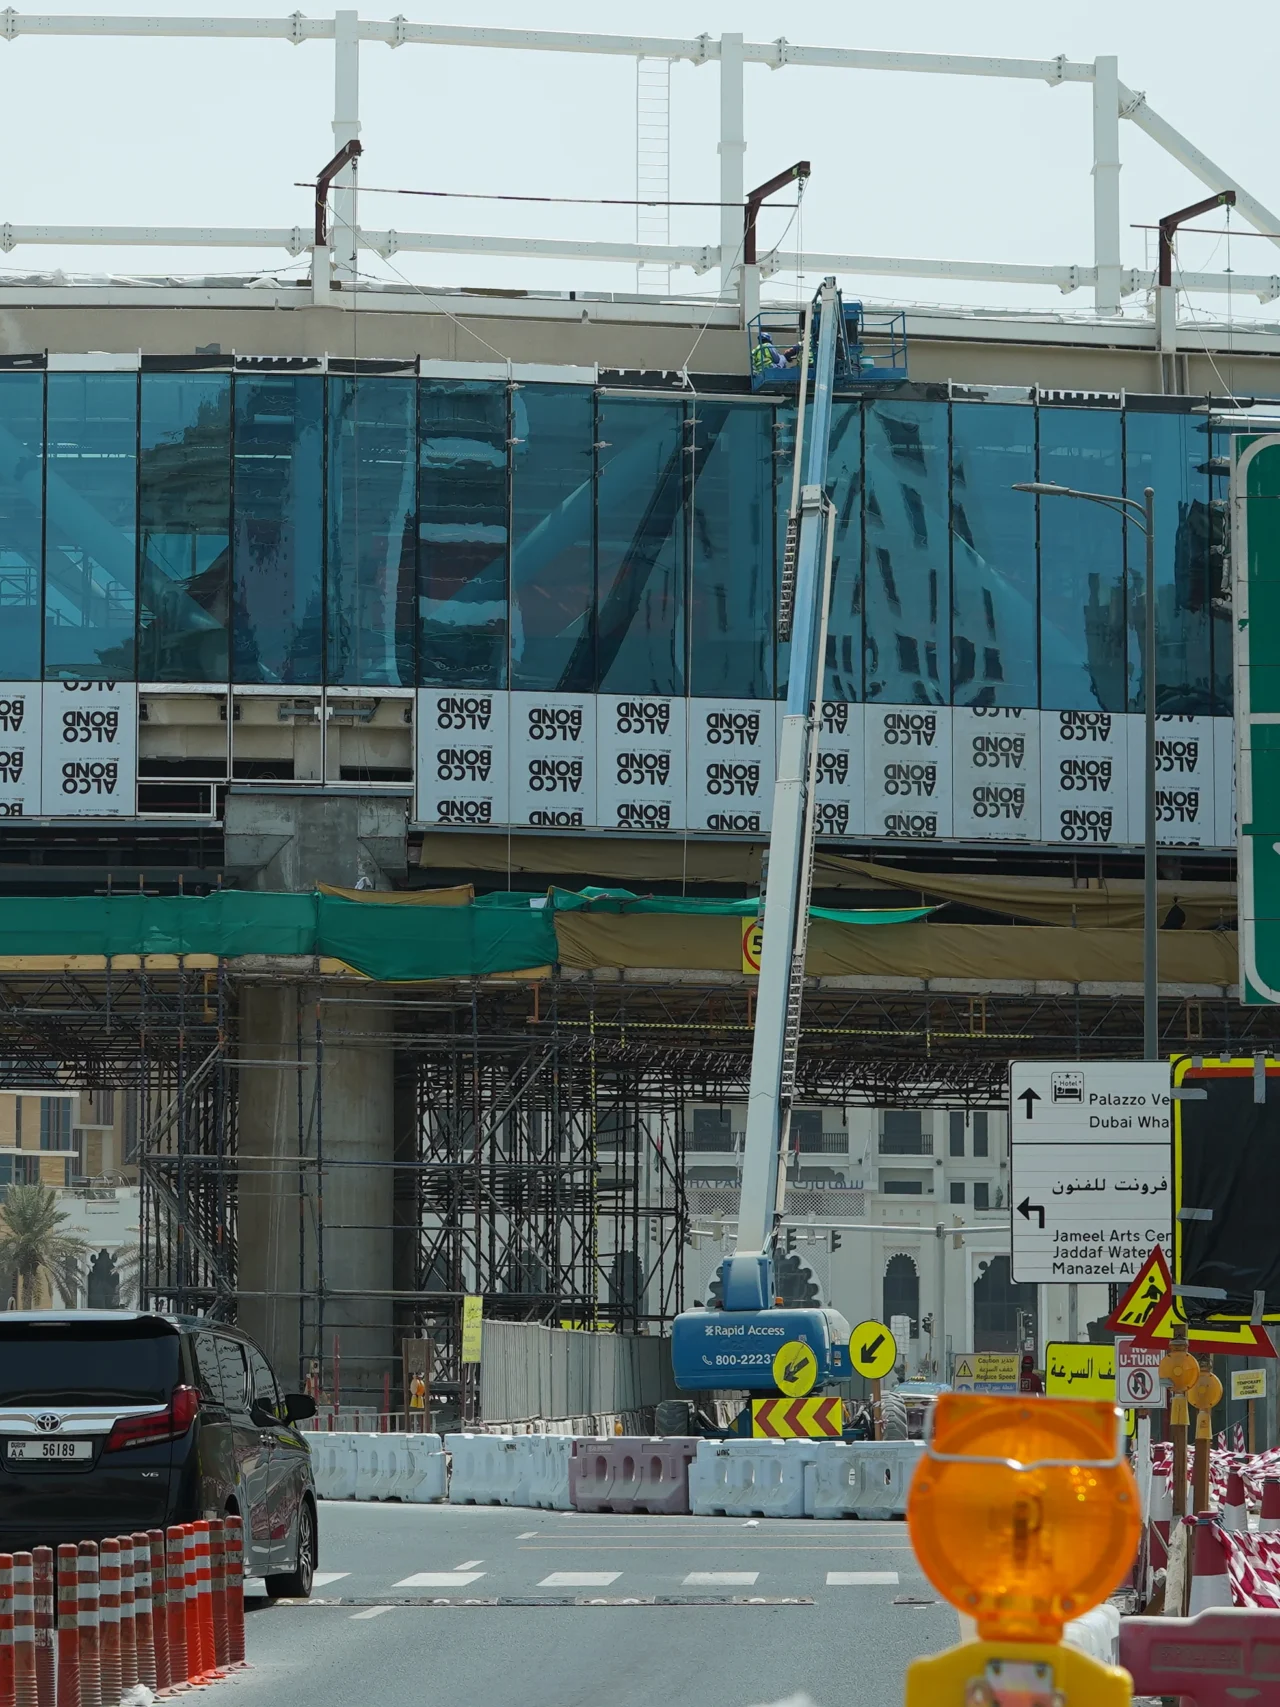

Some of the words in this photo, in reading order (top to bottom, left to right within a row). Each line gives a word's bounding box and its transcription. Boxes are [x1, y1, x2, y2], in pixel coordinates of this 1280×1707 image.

[437, 698, 491, 714] BOND
[617, 703, 669, 720] BOND
[63, 711, 118, 727] BOND
[437, 712, 490, 729] ALCO
[529, 709, 581, 726] BOND
[617, 718, 668, 734] ALCO
[707, 713, 759, 730] BOND
[884, 714, 935, 730] BOND
[63, 726, 117, 742] ALCO
[529, 724, 580, 741] ALCO
[707, 728, 758, 745] ALCO
[884, 728, 934, 745] ALCO
[973, 737, 1024, 754] BOND
[437, 749, 491, 766] BOND
[617, 753, 669, 770] BOND
[973, 752, 1023, 768] ALCO
[62, 763, 117, 779] BOND
[437, 764, 490, 781] ALCO
[529, 760, 582, 777] BOND
[617, 768, 668, 785] ALCO
[707, 764, 759, 781] BOND
[884, 764, 936, 781] BOND
[1060, 760, 1111, 776] BOND
[62, 778, 116, 794] ALCO
[529, 775, 581, 792] ALCO
[707, 779, 758, 796] ALCO
[884, 779, 935, 796] ALCO
[1060, 774, 1110, 791] ALCO
[973, 787, 1024, 804] BOND
[973, 802, 1023, 818] ALCO
[1060, 810, 1112, 826] BOND
[1060, 824, 1111, 841] ALCO
[1089, 1093, 1146, 1106] Palazzo
[1089, 1116, 1132, 1128] Dubai
[1138, 1116, 1170, 1128] Wha
[1052, 1178, 1106, 1195] للفنون
[1053, 1229, 1104, 1242] Jameel
[1110, 1230, 1140, 1242] Arts
[1053, 1246, 1104, 1259] Jaddaf
[1052, 1262, 1114, 1275] Manazel
[1120, 1262, 1135, 1275] Al
[715, 1325, 744, 1338] Rapid
[748, 1326, 785, 1336] Access
[1120, 1354, 1160, 1366] U-TURN
[10, 1449, 24, 1458] AA
[42, 1443, 75, 1457] 56189
